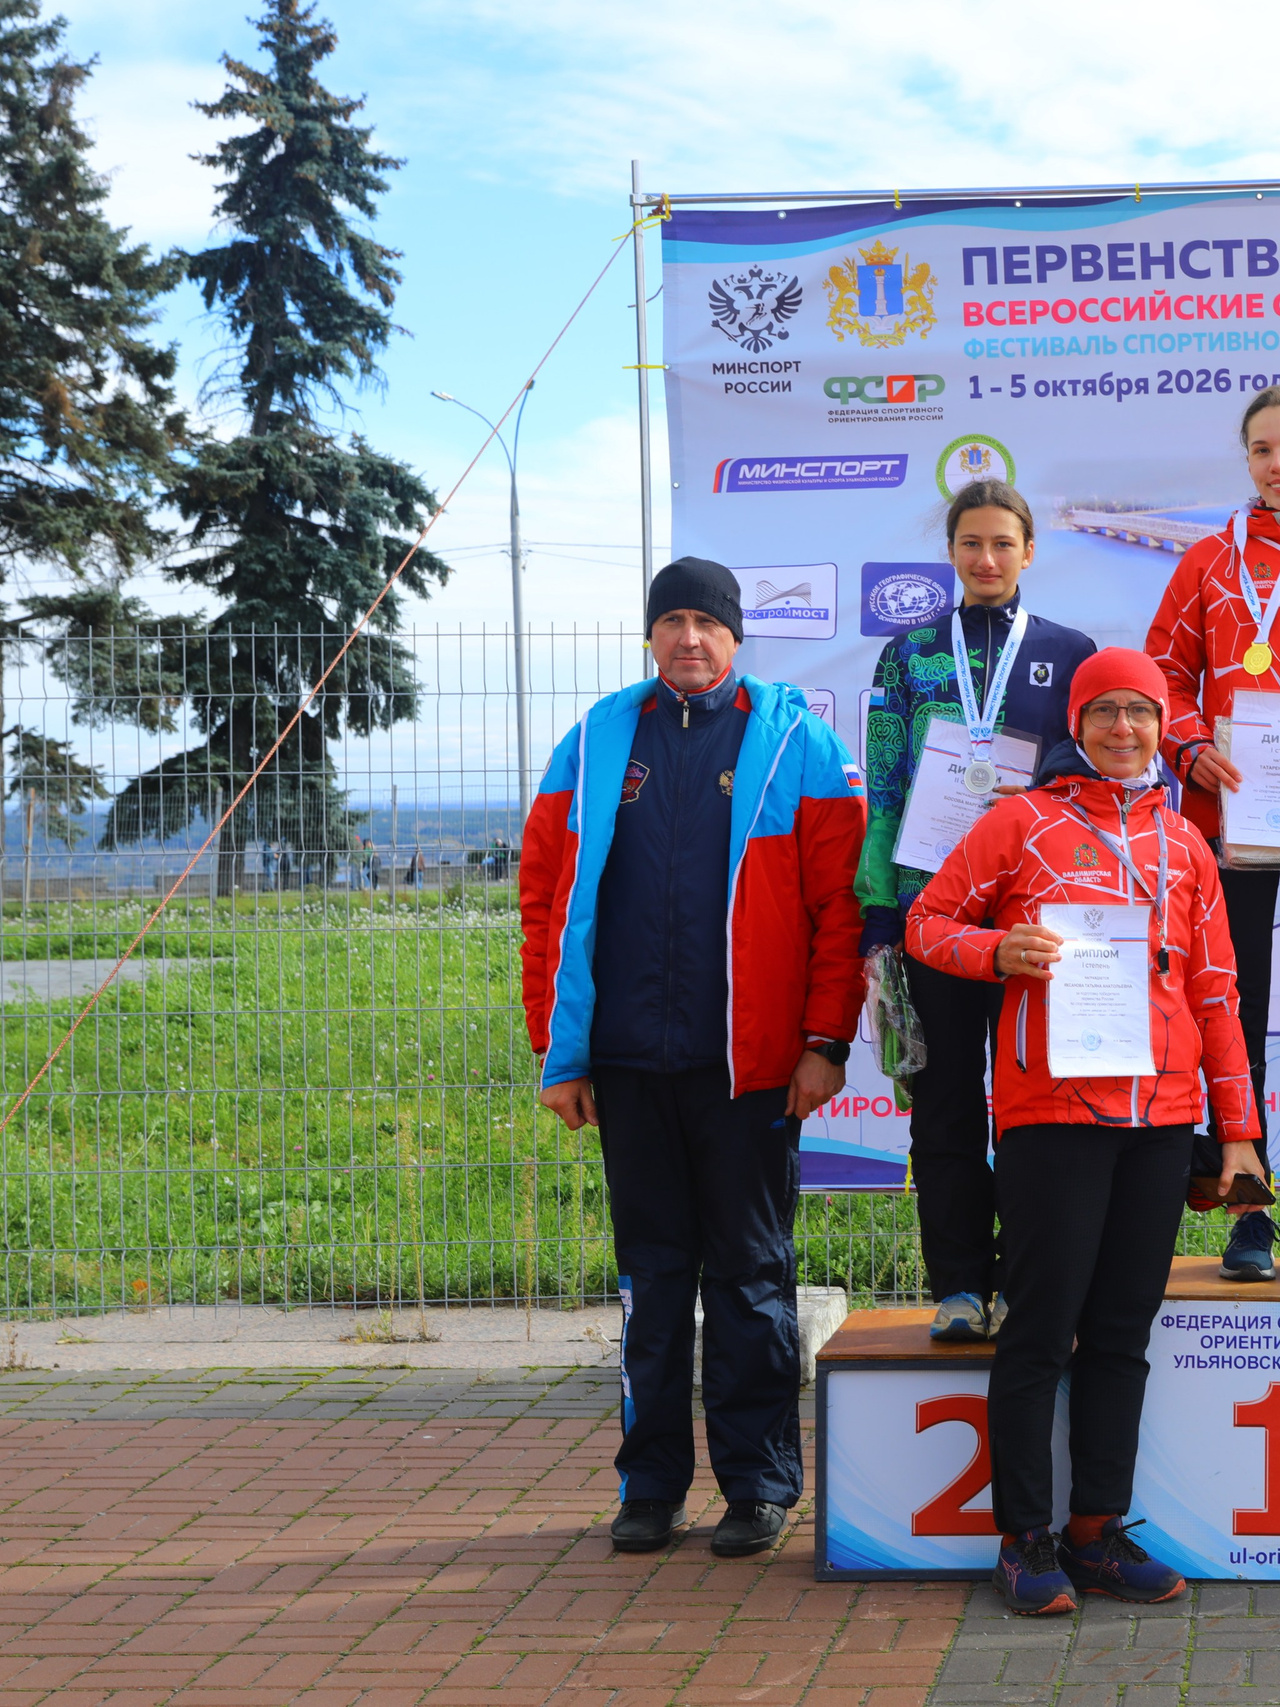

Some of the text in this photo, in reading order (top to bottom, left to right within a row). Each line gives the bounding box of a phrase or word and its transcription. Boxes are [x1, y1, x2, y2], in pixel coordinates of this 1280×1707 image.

[963, 289, 1265, 327] ВСЕРОССИЙСКИЕ
[963, 335, 1118, 360] ФЕСТИВАЛЬ
[712, 360, 801, 375] МИНСПОРТ
[724, 381, 792, 394] РОССИИ
[969, 375, 983, 399] 1
[1010, 374, 1026, 398] 5
[1034, 371, 1149, 402] октября
[1157, 368, 1232, 394] 2026
[828, 406, 943, 416] ФЕДЕРАЦИЯ СПОРТИВНОГО
[828, 414, 943, 424] ОРИЕНТИРОВАНИЯ РОССИИ
[738, 460, 900, 479] МИНСПОРТ
[1074, 948, 1119, 958] ДИПЛОМ
[1160, 1314, 1272, 1332] ФЕДЕРАЦИЯ
[911, 1392, 1004, 1537] 2
